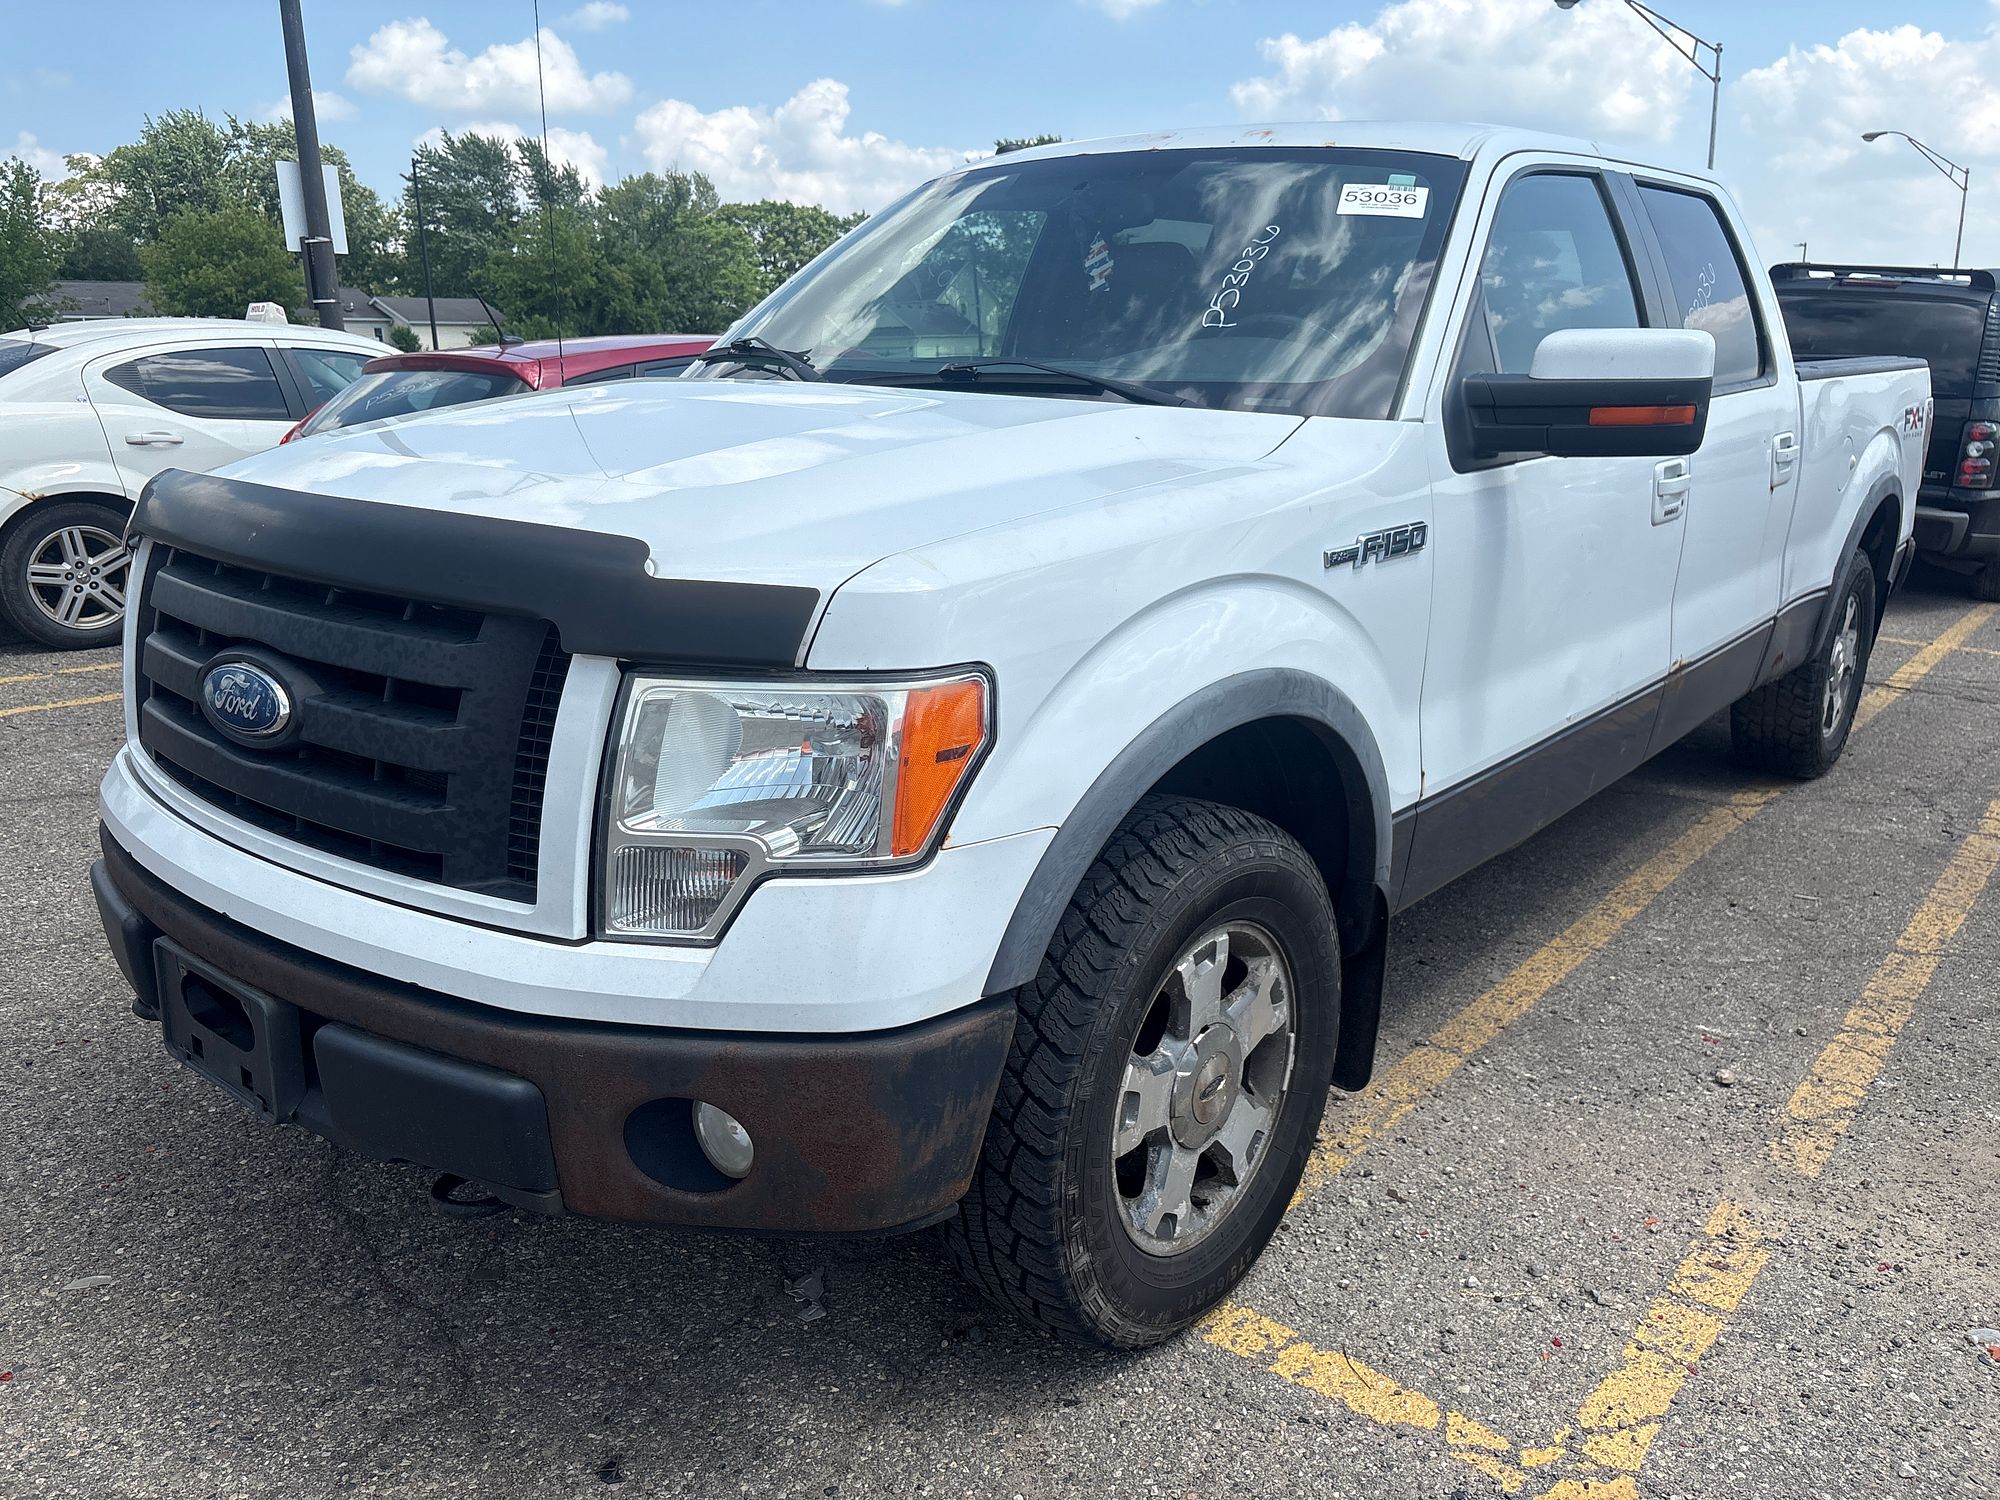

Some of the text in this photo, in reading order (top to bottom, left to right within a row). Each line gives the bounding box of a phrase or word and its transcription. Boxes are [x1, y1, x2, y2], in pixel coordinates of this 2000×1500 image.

[1344, 190, 1418, 205] 53036
[1202, 225, 1280, 328] P53036
[251, 304, 266, 313] HOLD
[1903, 406, 1924, 432] FX4
[1353, 521, 1428, 569] F-150
[214, 674, 261, 720] Ford
